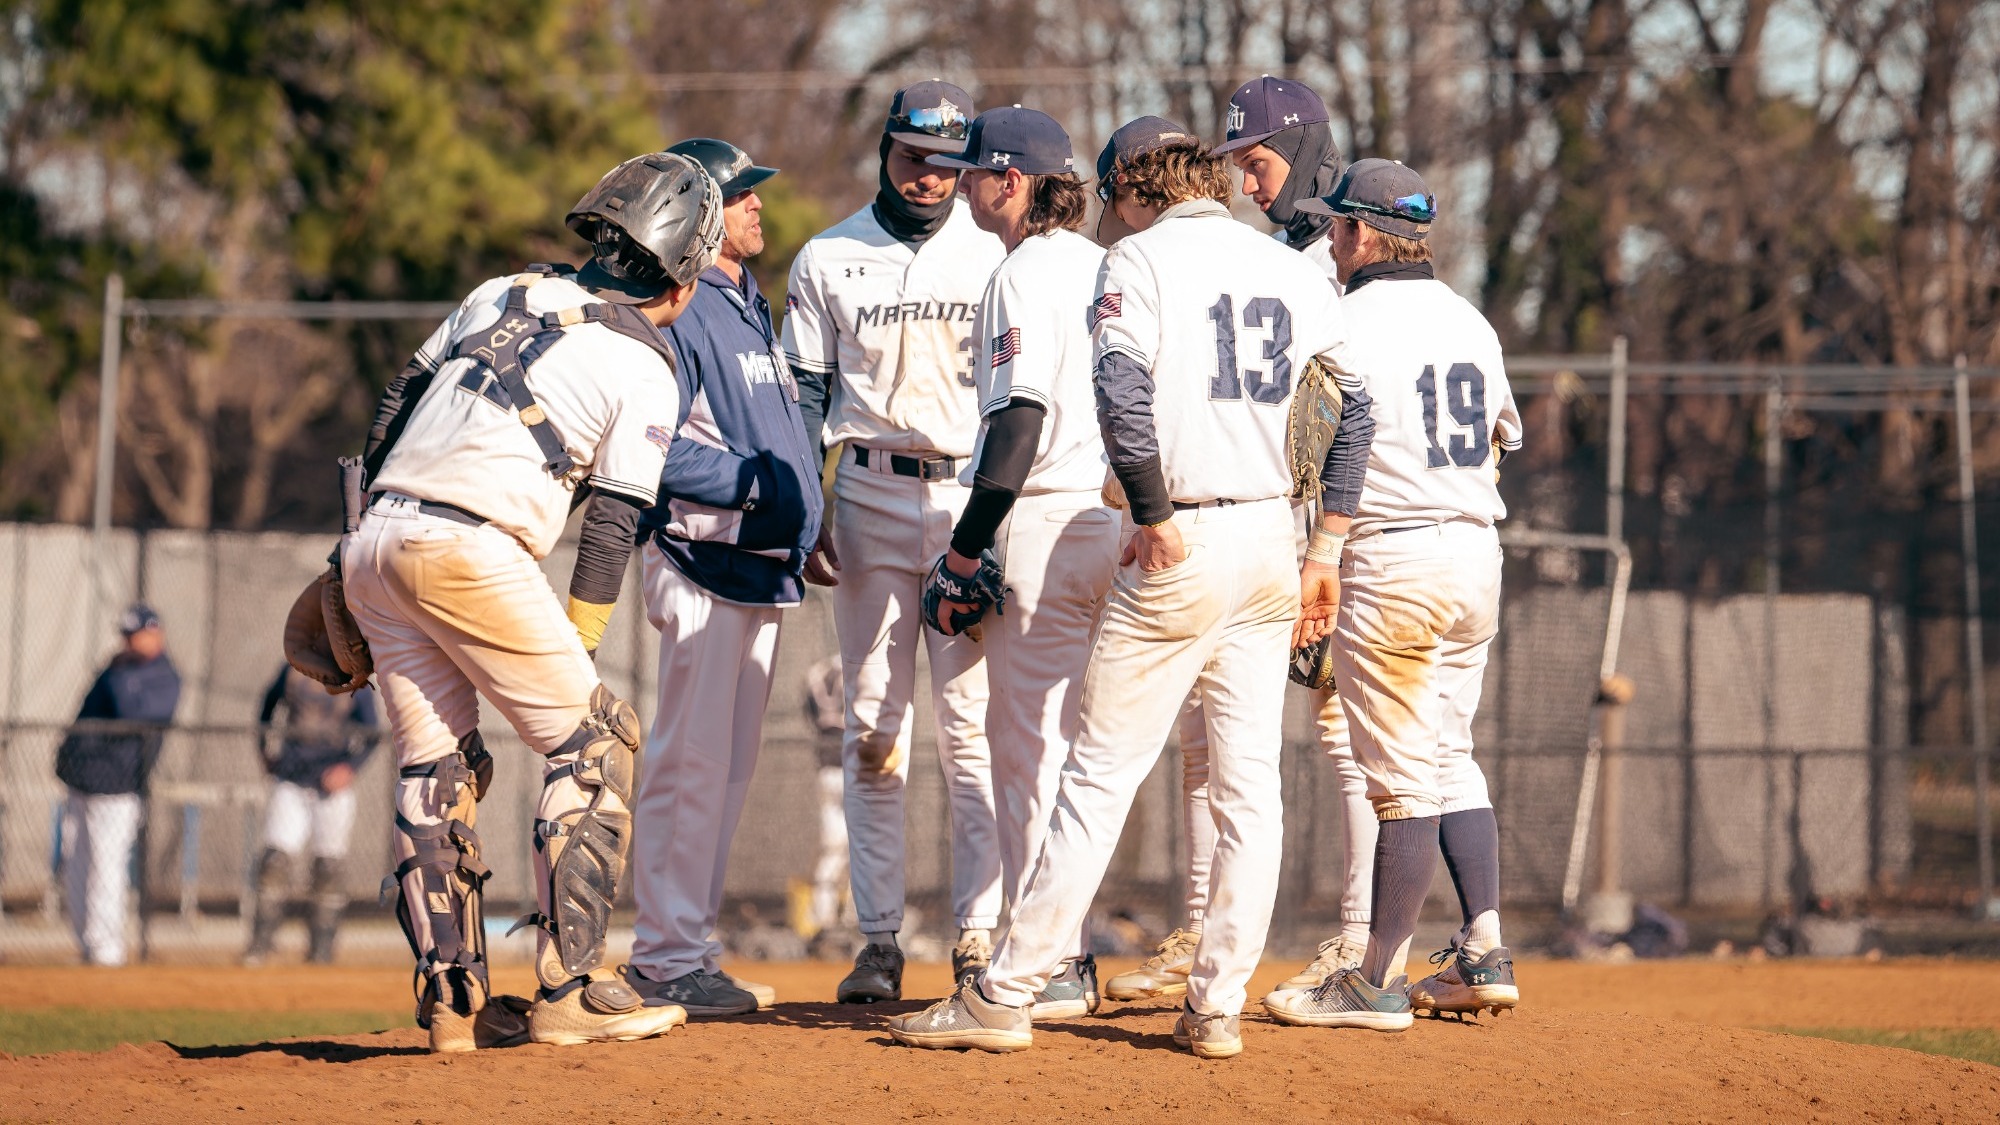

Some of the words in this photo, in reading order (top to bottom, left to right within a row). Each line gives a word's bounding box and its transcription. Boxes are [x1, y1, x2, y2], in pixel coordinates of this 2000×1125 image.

[854, 301, 979, 338] MARLINS
[1207, 293, 1292, 405] 13
[1415, 362, 1490, 469] 19
